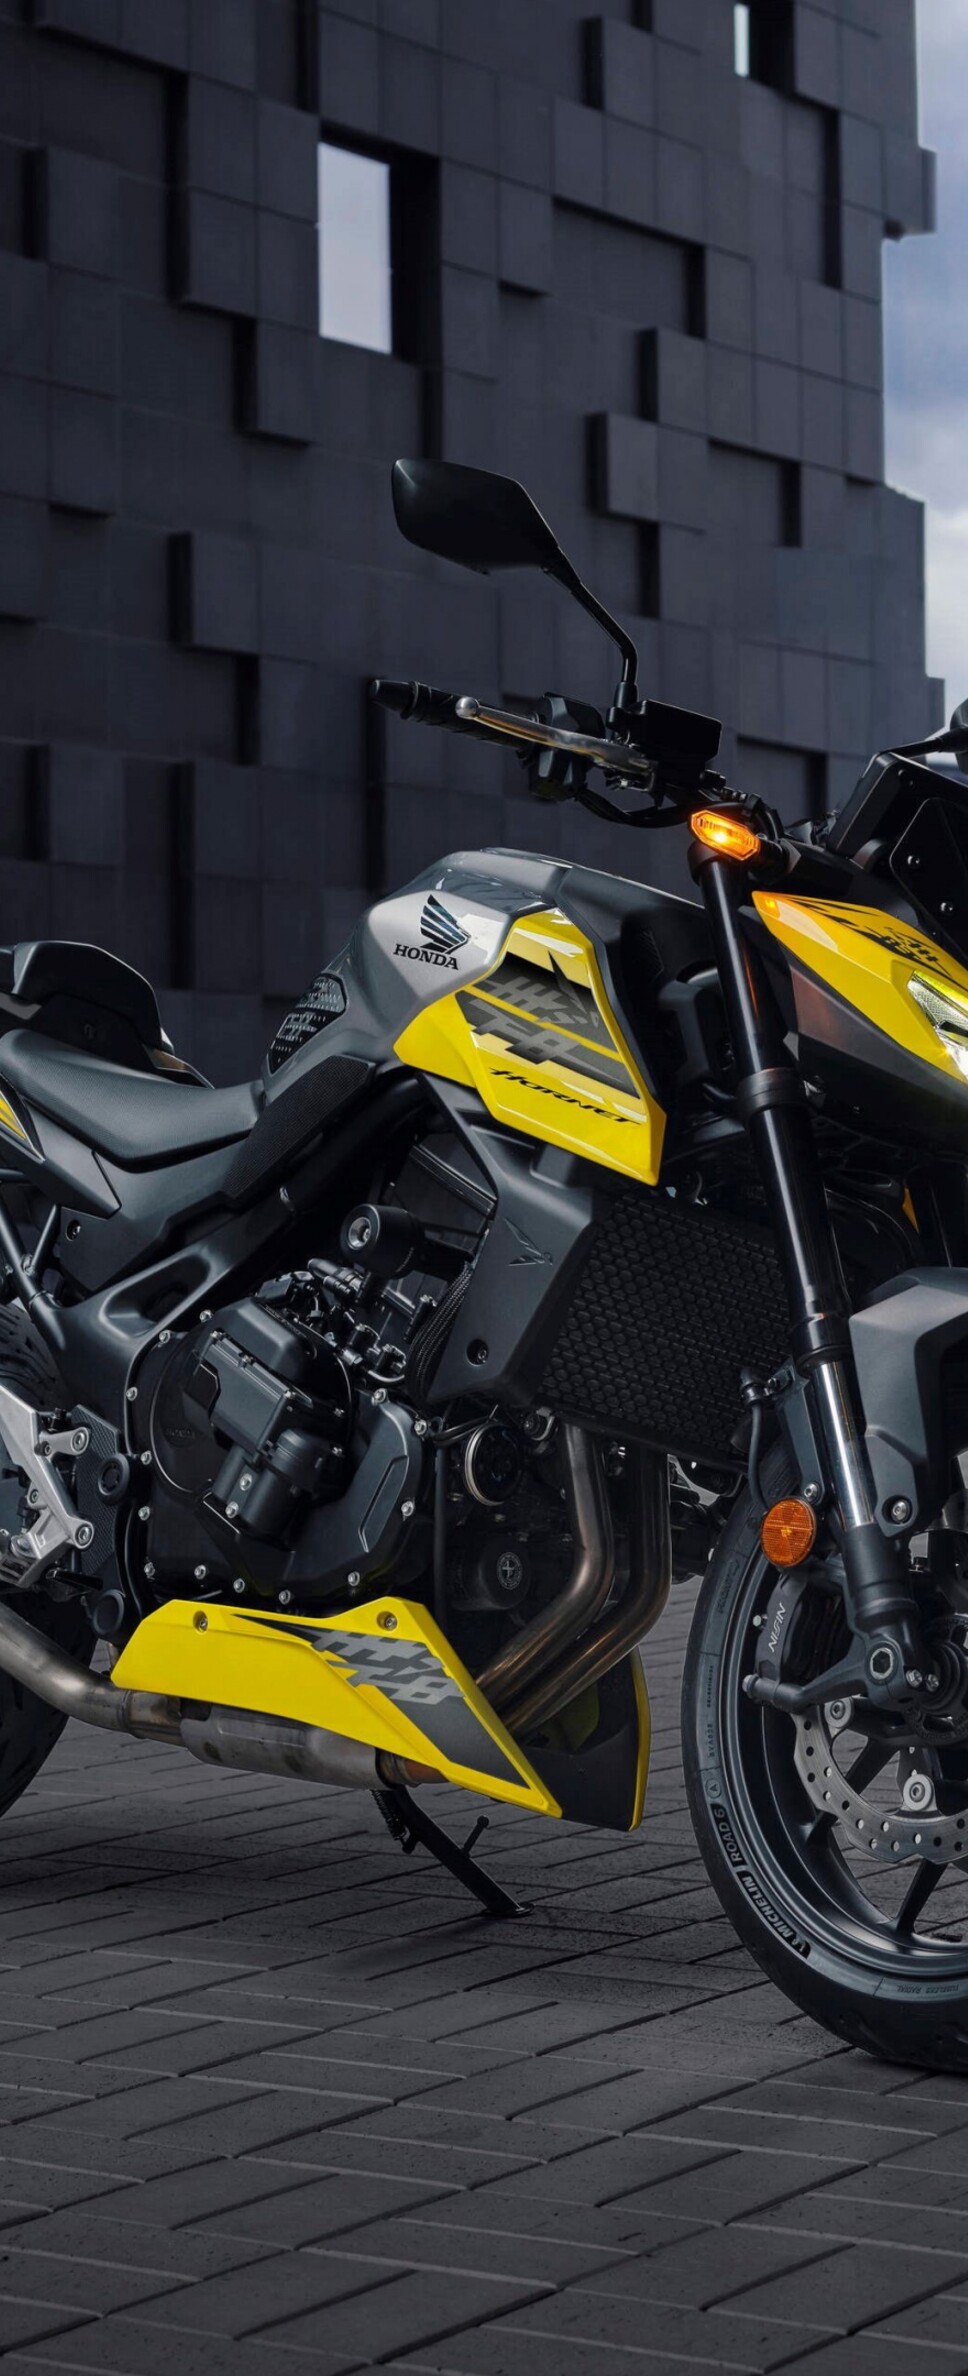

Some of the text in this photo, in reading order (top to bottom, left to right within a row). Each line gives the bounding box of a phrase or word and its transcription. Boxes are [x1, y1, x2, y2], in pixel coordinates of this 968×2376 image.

[393, 943, 459, 971] HONDA
[489, 1066, 642, 1126] HORNET
[768, 1602, 787, 1653] NISSIN
[714, 1807, 798, 1938] MICHELIN ROAD 6
